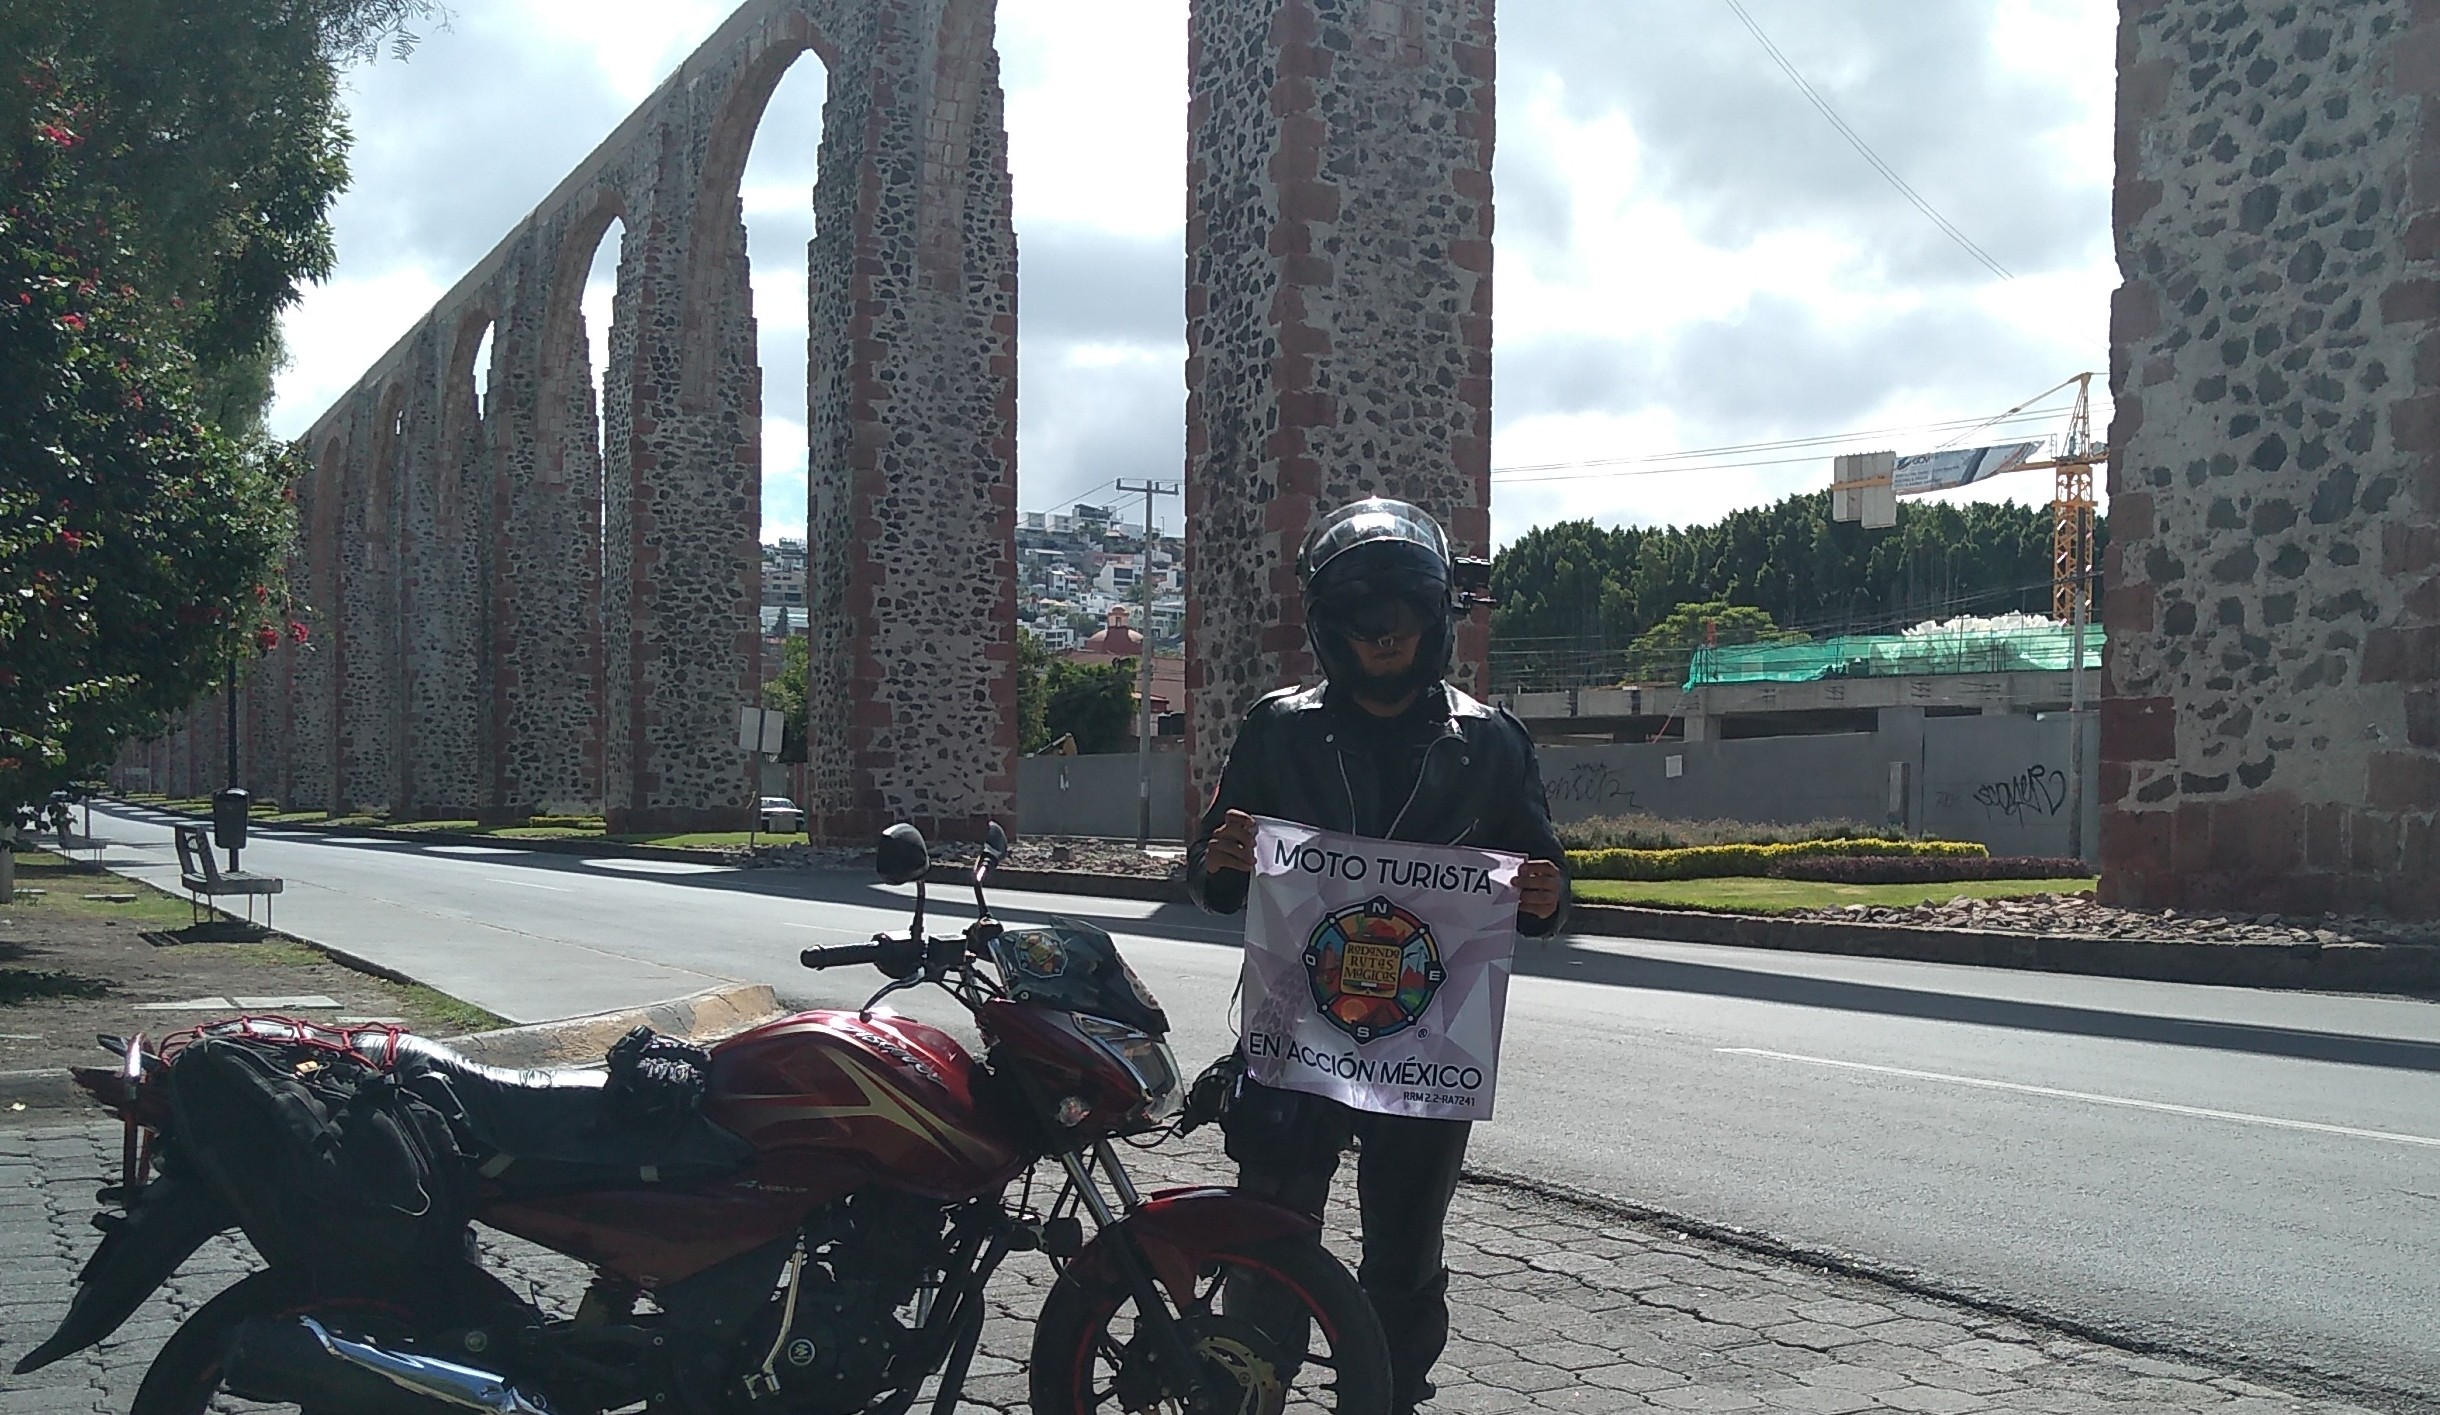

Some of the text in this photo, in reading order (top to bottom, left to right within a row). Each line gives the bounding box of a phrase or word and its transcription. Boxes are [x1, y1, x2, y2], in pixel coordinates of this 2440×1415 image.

[1274, 838, 1492, 895] MOTO TURISTA
[1371, 902, 1388, 914] N
[1428, 970, 1441, 981] E
[1356, 1026, 1370, 1038] S
[1249, 1031, 1483, 1090] EN ACCIÓN MÉXICO
